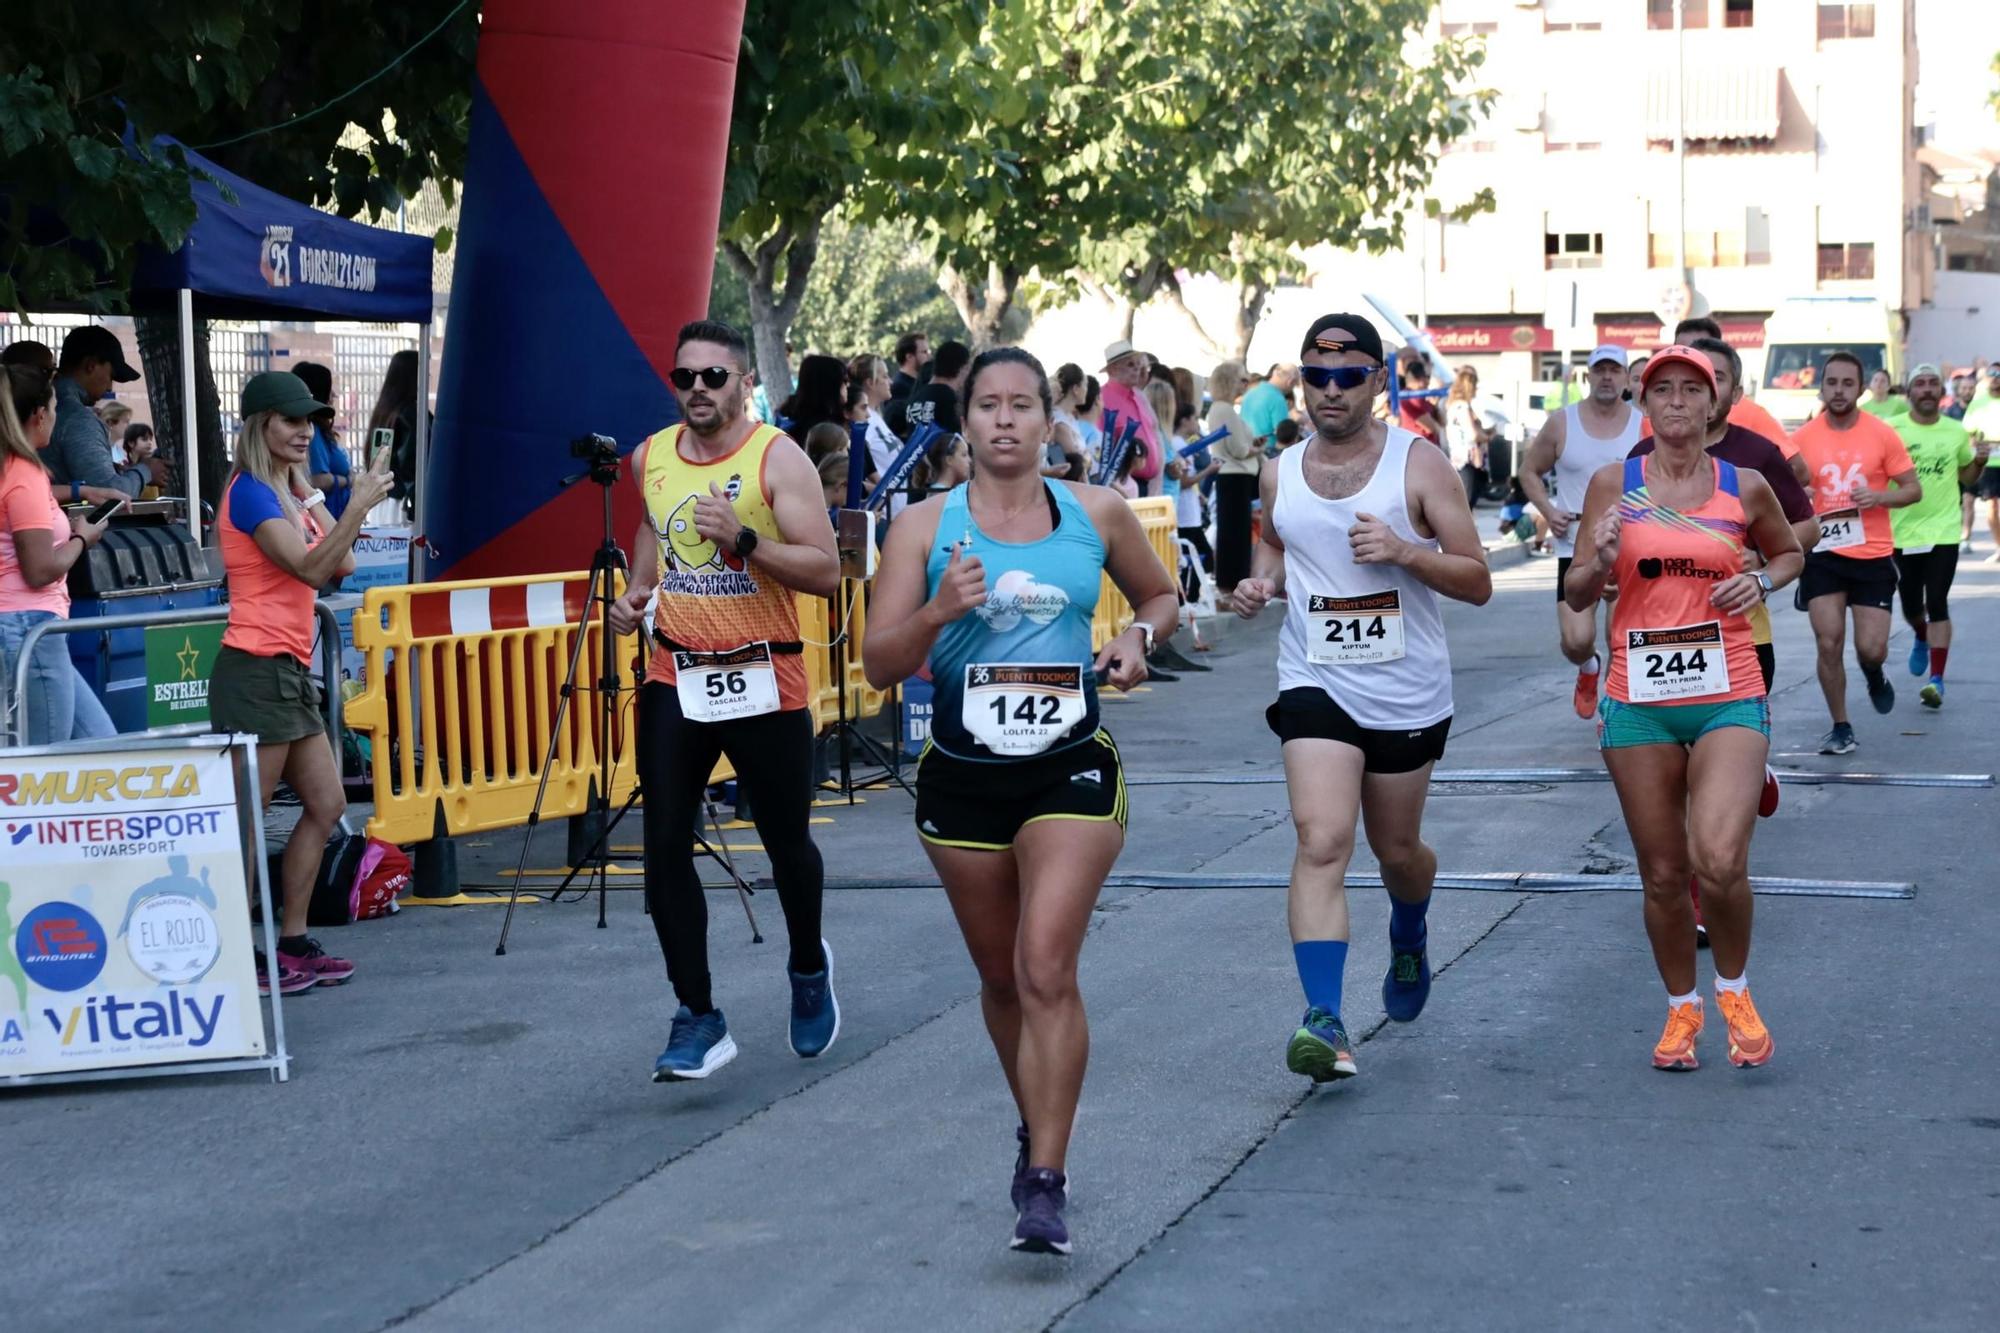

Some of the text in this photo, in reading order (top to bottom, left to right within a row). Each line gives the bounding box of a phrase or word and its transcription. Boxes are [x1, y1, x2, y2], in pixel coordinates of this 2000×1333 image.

[271, 243, 290, 287] 21
[299, 246, 377, 292] DORSAL21.COM
[1820, 463, 1868, 497] 36
[1822, 521, 1851, 538] 241
[1664, 558, 1694, 570] pan
[699, 573, 750, 584] DEPORTIVA
[1667, 567, 1725, 581] moreno
[705, 582, 758, 596] RUNNING
[1312, 596, 1324, 610] 36
[1324, 616, 1386, 642] 214
[1632, 632, 1645, 645] 36
[1645, 648, 1707, 678] 244
[974, 667, 989, 684] 36
[995, 672, 1034, 682] PUENTE
[1037, 673, 1077, 682] TOCINOS
[706, 671, 747, 698] 56
[708, 695, 748, 706] CASCALES
[909, 703, 925, 715] Tu
[990, 695, 1063, 725] 142
[1003, 728, 1049, 736] LOLITA 22
[37, 811, 221, 845] INTERSPORT
[81, 840, 176, 858] TOVARSPORT
[140, 917, 206, 948] EL ROJO
